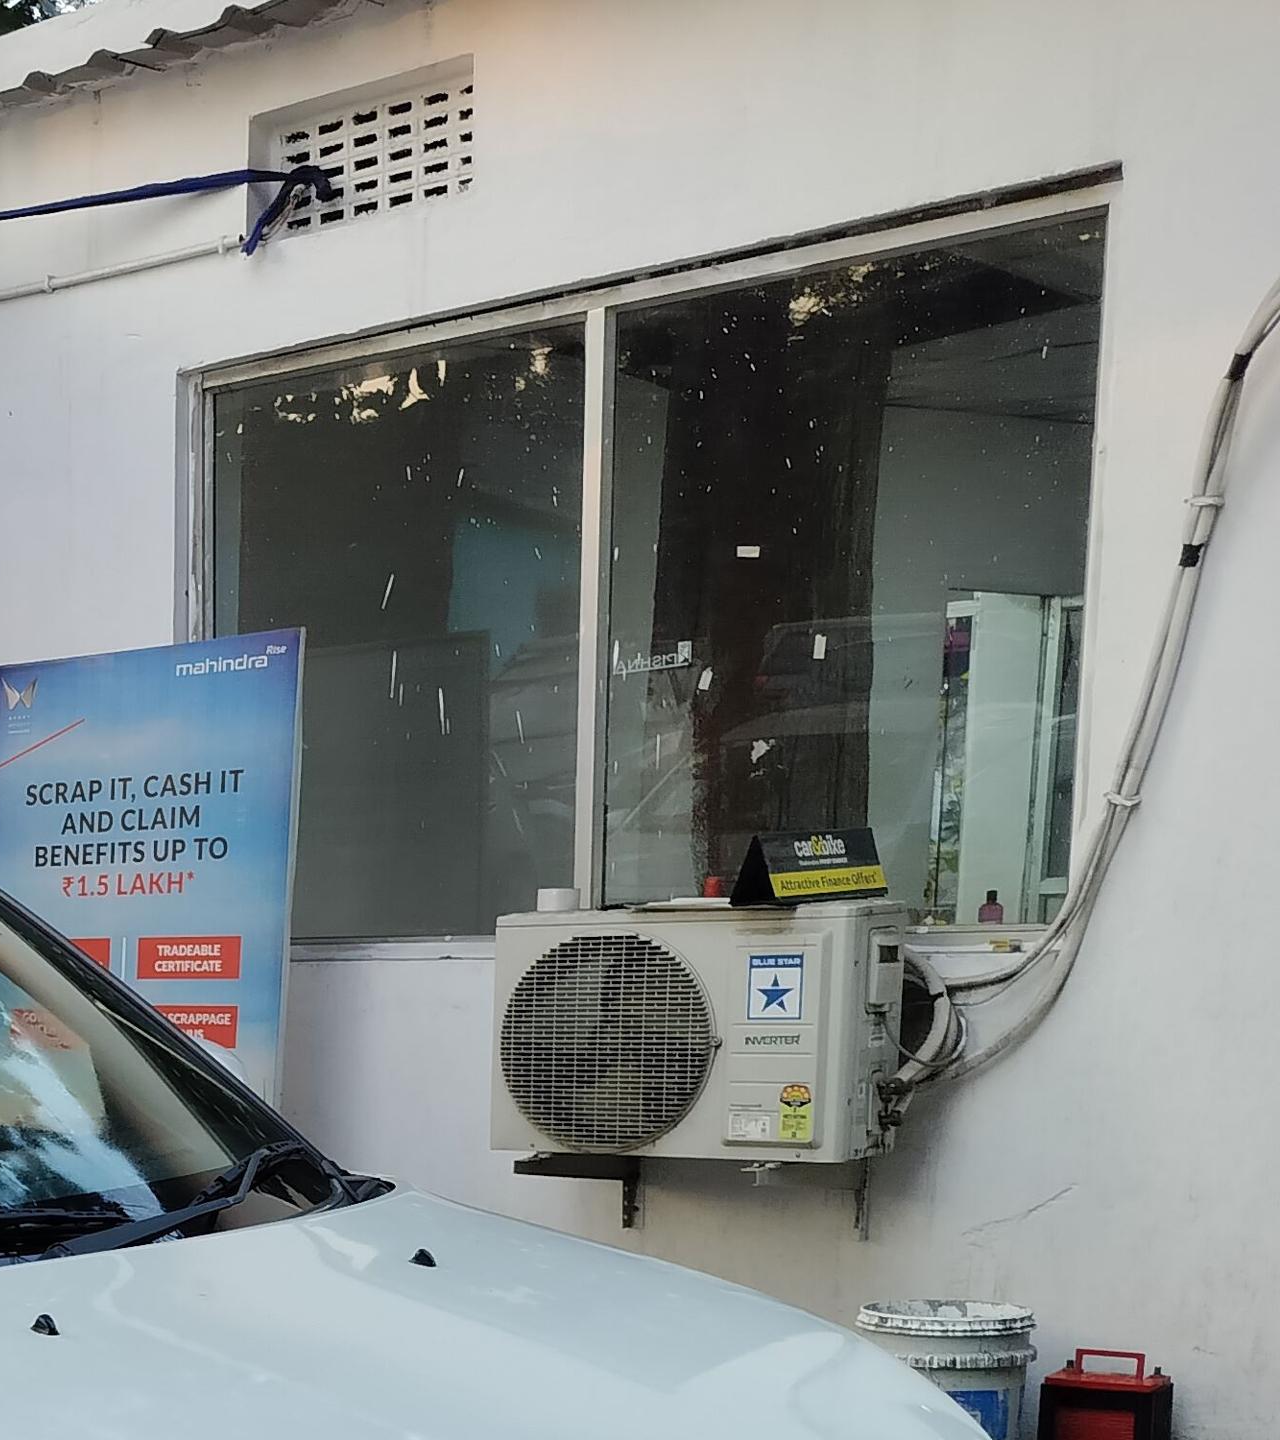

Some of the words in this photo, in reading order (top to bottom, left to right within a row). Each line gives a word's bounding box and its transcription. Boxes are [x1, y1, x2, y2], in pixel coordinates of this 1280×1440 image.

[175, 654, 268, 677] mahindra
[266, 645, 287, 655] Rise
[25, 780, 102, 806] SCRAP
[110, 777, 136, 803] IT,
[143, 771, 212, 798] CASH
[220, 769, 244, 793] IT
[61, 811, 114, 835] AND
[121, 805, 201, 832] CLAIM
[35, 841, 145, 868] BENEFITS
[153, 839, 186, 862] UP
[193, 836, 228, 860] TO
[793, 834, 846, 857] car&bike
[62, 874, 109, 897] ₹1.5
[780, 878, 820, 891] Attractive
[821, 875, 851, 888] Finance
[156, 944, 221, 957] TRADEABLE
[154, 960, 222, 973] CERTIFICATE
[752, 958, 776, 966] BLUE
[777, 957, 801, 966] STAR
[168, 1013, 232, 1025] SCRAPPAGE
[744, 1034, 801, 1046] INVERTER
